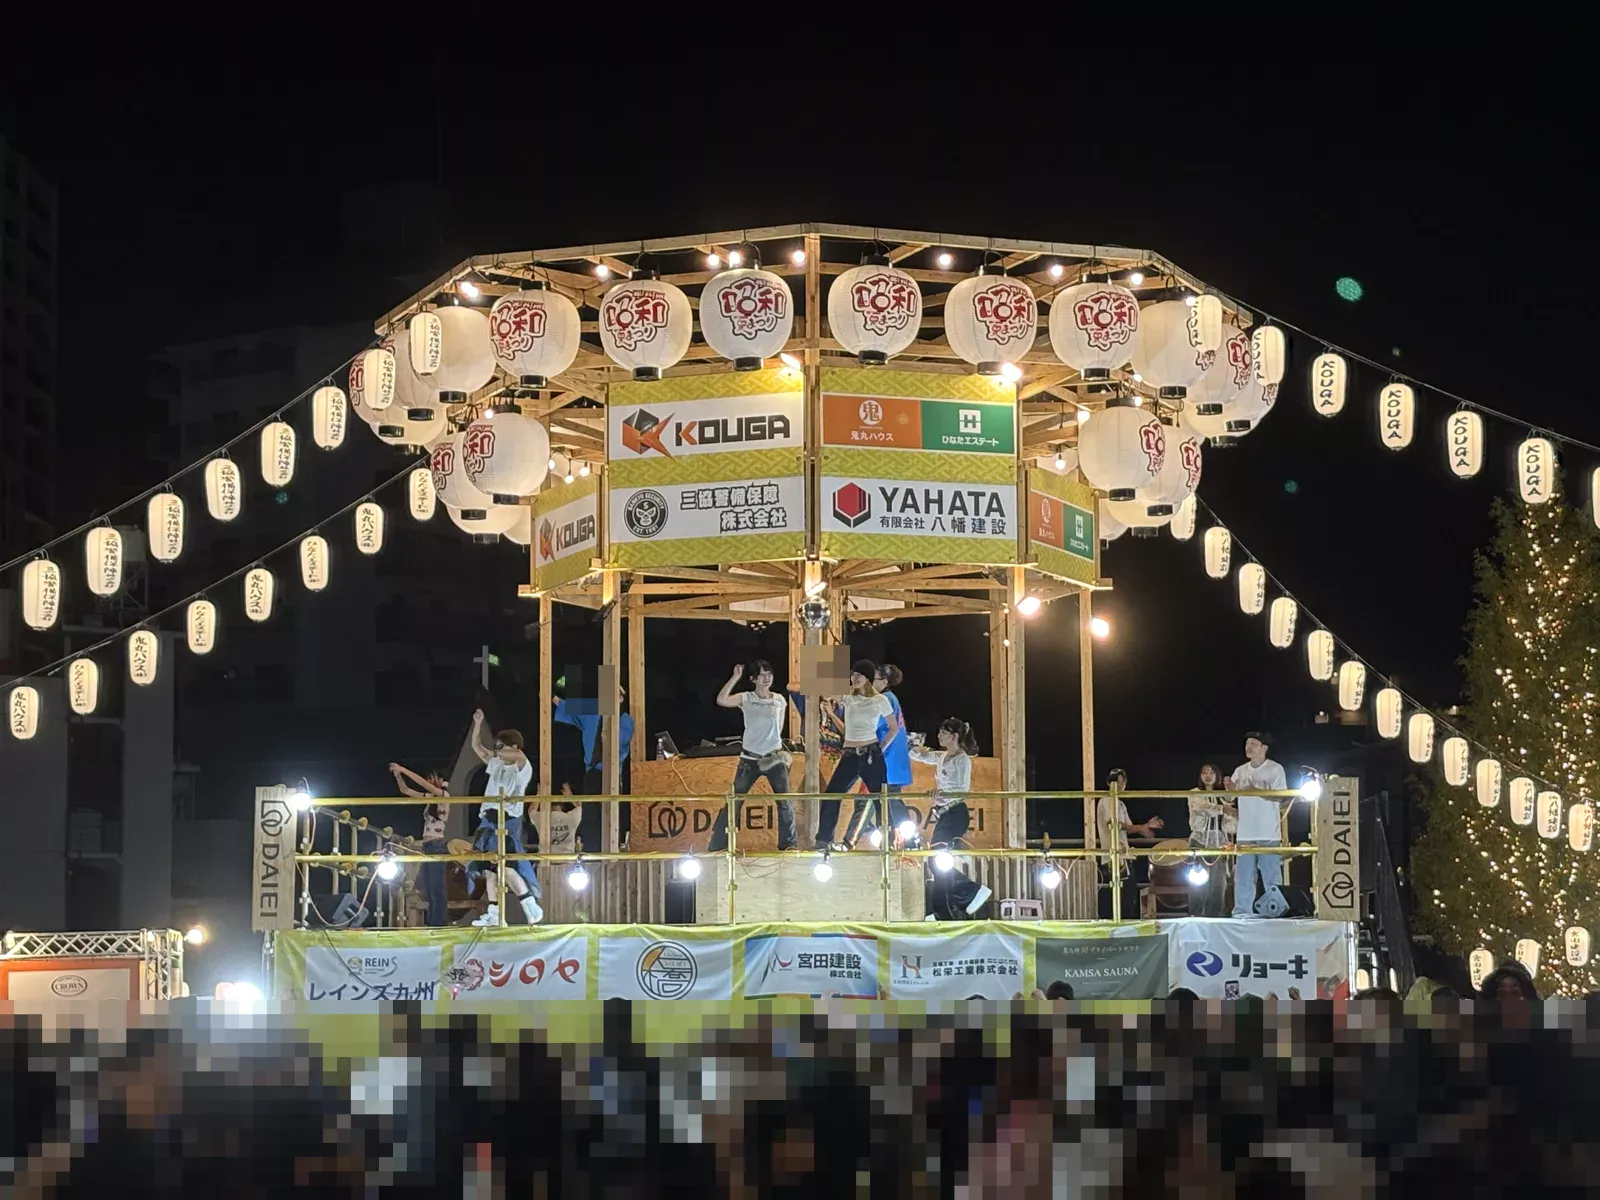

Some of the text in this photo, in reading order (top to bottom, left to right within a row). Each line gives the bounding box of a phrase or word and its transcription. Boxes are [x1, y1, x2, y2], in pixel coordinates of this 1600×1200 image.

[1319, 360, 1336, 408] KOUGA
[1387, 389, 1402, 440] KOUGA
[675, 414, 791, 447] KOUGA
[850, 430, 894, 441] 鬼丸ハウス
[942, 435, 1000, 447] ひなたエステート
[1454, 416, 1470, 468] KOUGA
[1526, 444, 1542, 497] KOUGA
[680, 483, 779, 510] 三協警備保障
[878, 486, 1006, 518] YAHATA
[556, 514, 595, 551] KOUGA
[720, 507, 788, 533] 株式会社
[880, 515, 1007, 535] 有限会社 八幡建設
[693, 805, 773, 834] DEI
[1333, 790, 1351, 865] DAIEI
[260, 842, 280, 918] DAIEI
[364, 956, 398, 977] REINS
[797, 952, 862, 970] 宮田建設
[932, 965, 1018, 977] 松栄工業株式会社
[1064, 966, 1139, 978] KAMSA SAUNA
[1231, 953, 1309, 979] リョーキ
[829, 970, 862, 979] 株式会社
[310, 981, 434, 1000] レインズ九州
